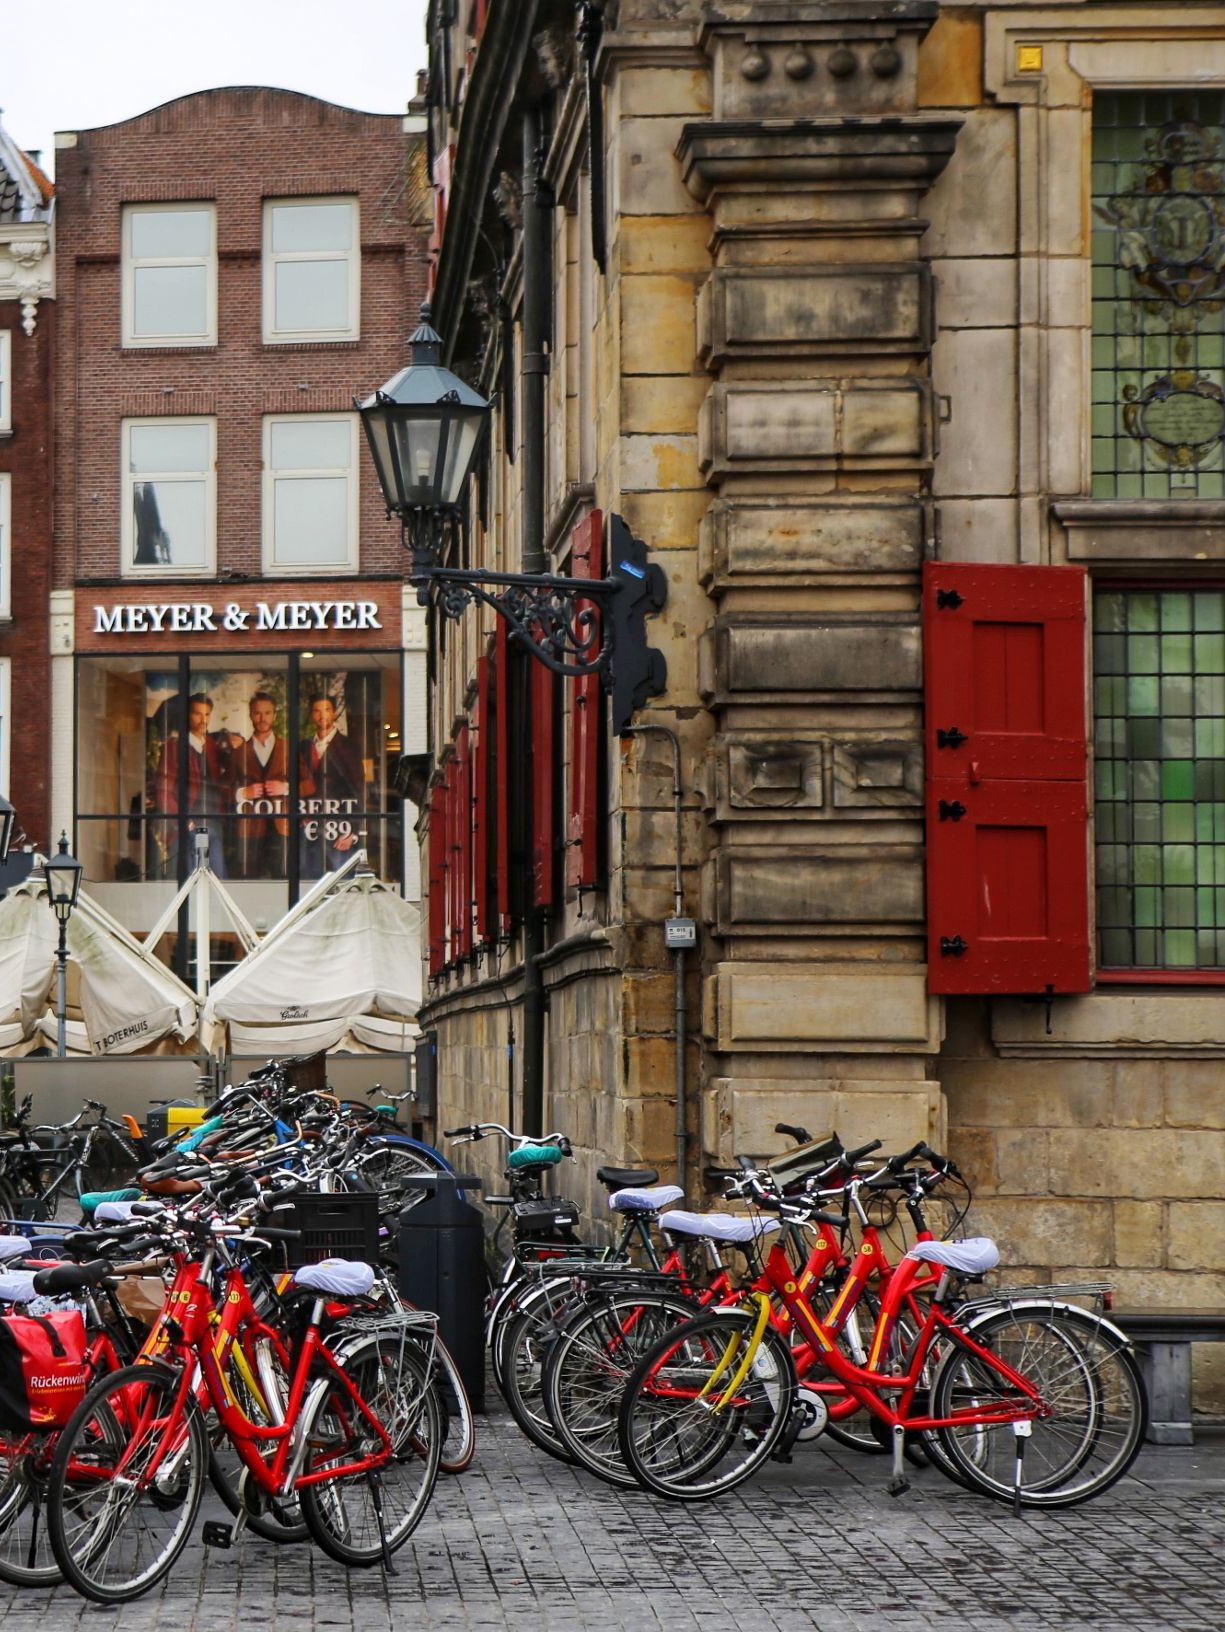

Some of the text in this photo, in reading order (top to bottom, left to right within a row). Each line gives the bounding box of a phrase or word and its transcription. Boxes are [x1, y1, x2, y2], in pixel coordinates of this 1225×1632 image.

[93, 601, 383, 633] MEYER & MEYER
[103, 1020, 148, 1047] BOTERHUIS
[31, 1374, 85, 1388] Rückenwin
